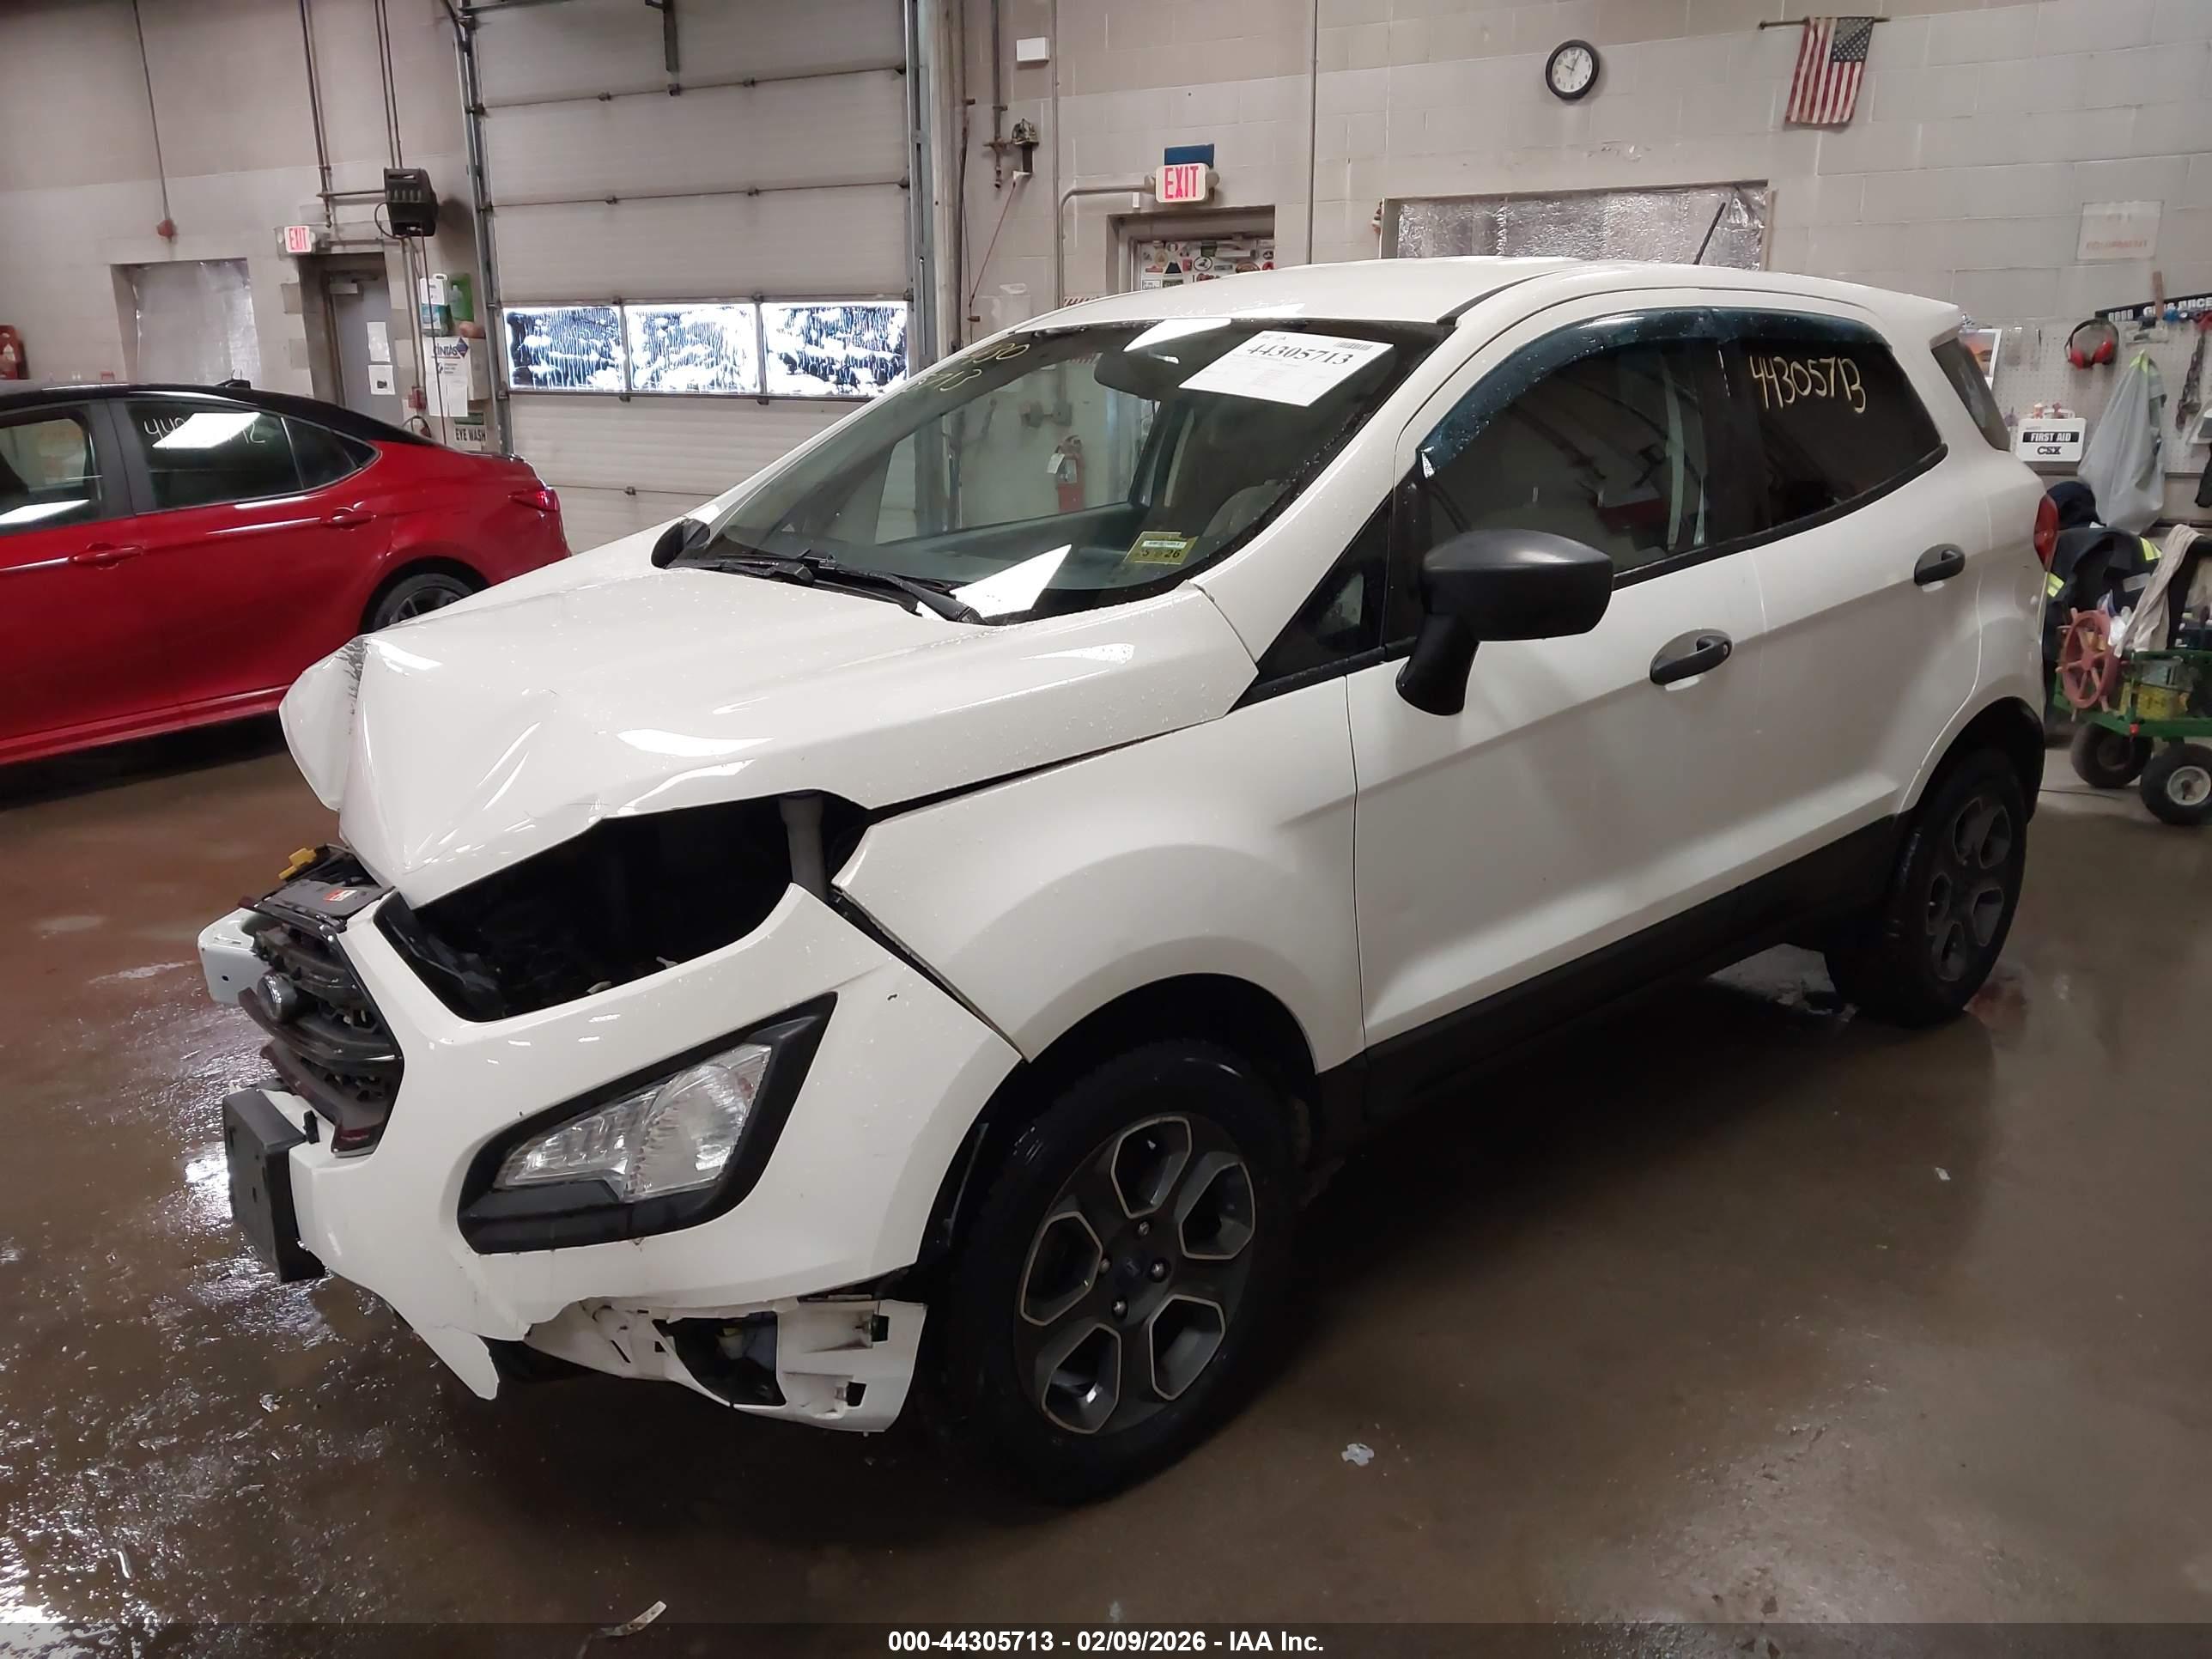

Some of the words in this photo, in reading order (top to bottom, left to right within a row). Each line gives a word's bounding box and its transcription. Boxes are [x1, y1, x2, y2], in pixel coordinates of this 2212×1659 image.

[1164, 166, 1199, 198] EXIT
[289, 227, 307, 250] EXIT
[1247, 343, 1354, 365] 44305713
[1749, 356, 1867, 413] 44305713
[2030, 432, 2055, 441] FIRST
[2056, 432, 2072, 441] AID
[2037, 446, 2062, 455] CSX
[1164, 549, 1182, 558] 26
